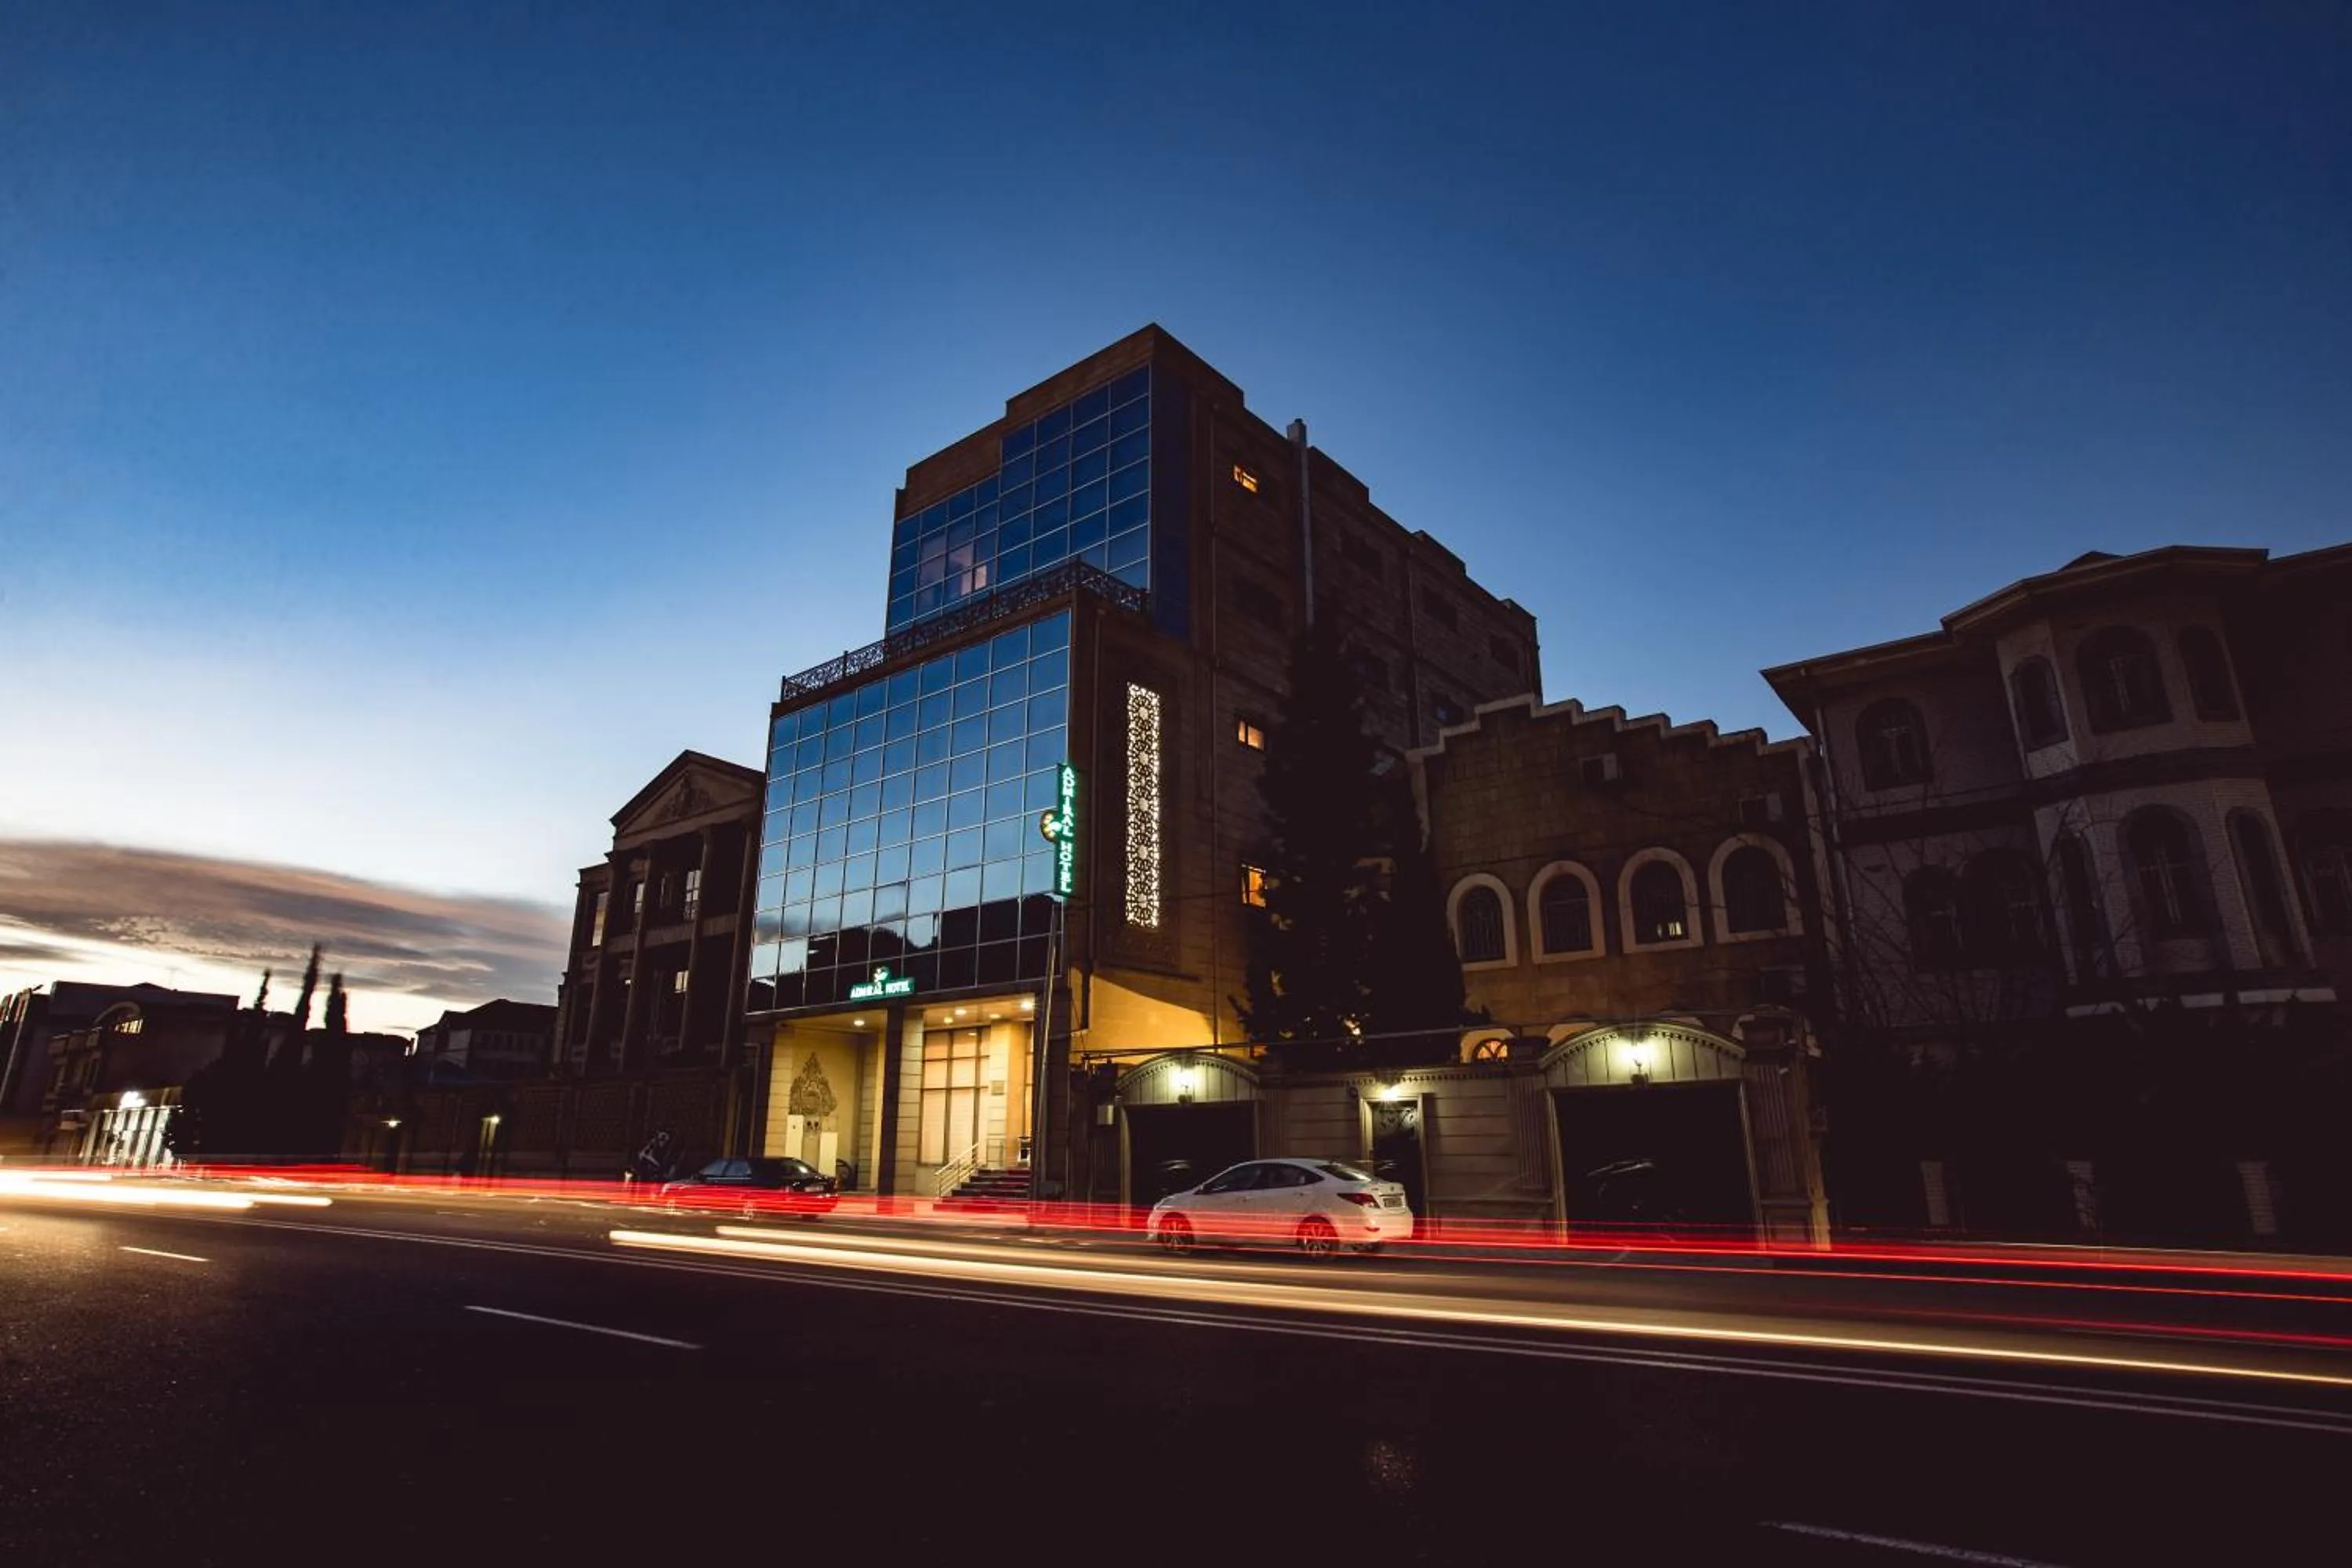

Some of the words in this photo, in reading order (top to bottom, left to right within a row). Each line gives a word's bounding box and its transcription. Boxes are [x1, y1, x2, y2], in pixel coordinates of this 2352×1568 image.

[1062, 766, 1076, 837] ADMIRAL
[1058, 840, 1073, 892] HOTEL
[850, 983, 884, 998] ADMIRAL
[886, 981, 910, 994] HOTEL
